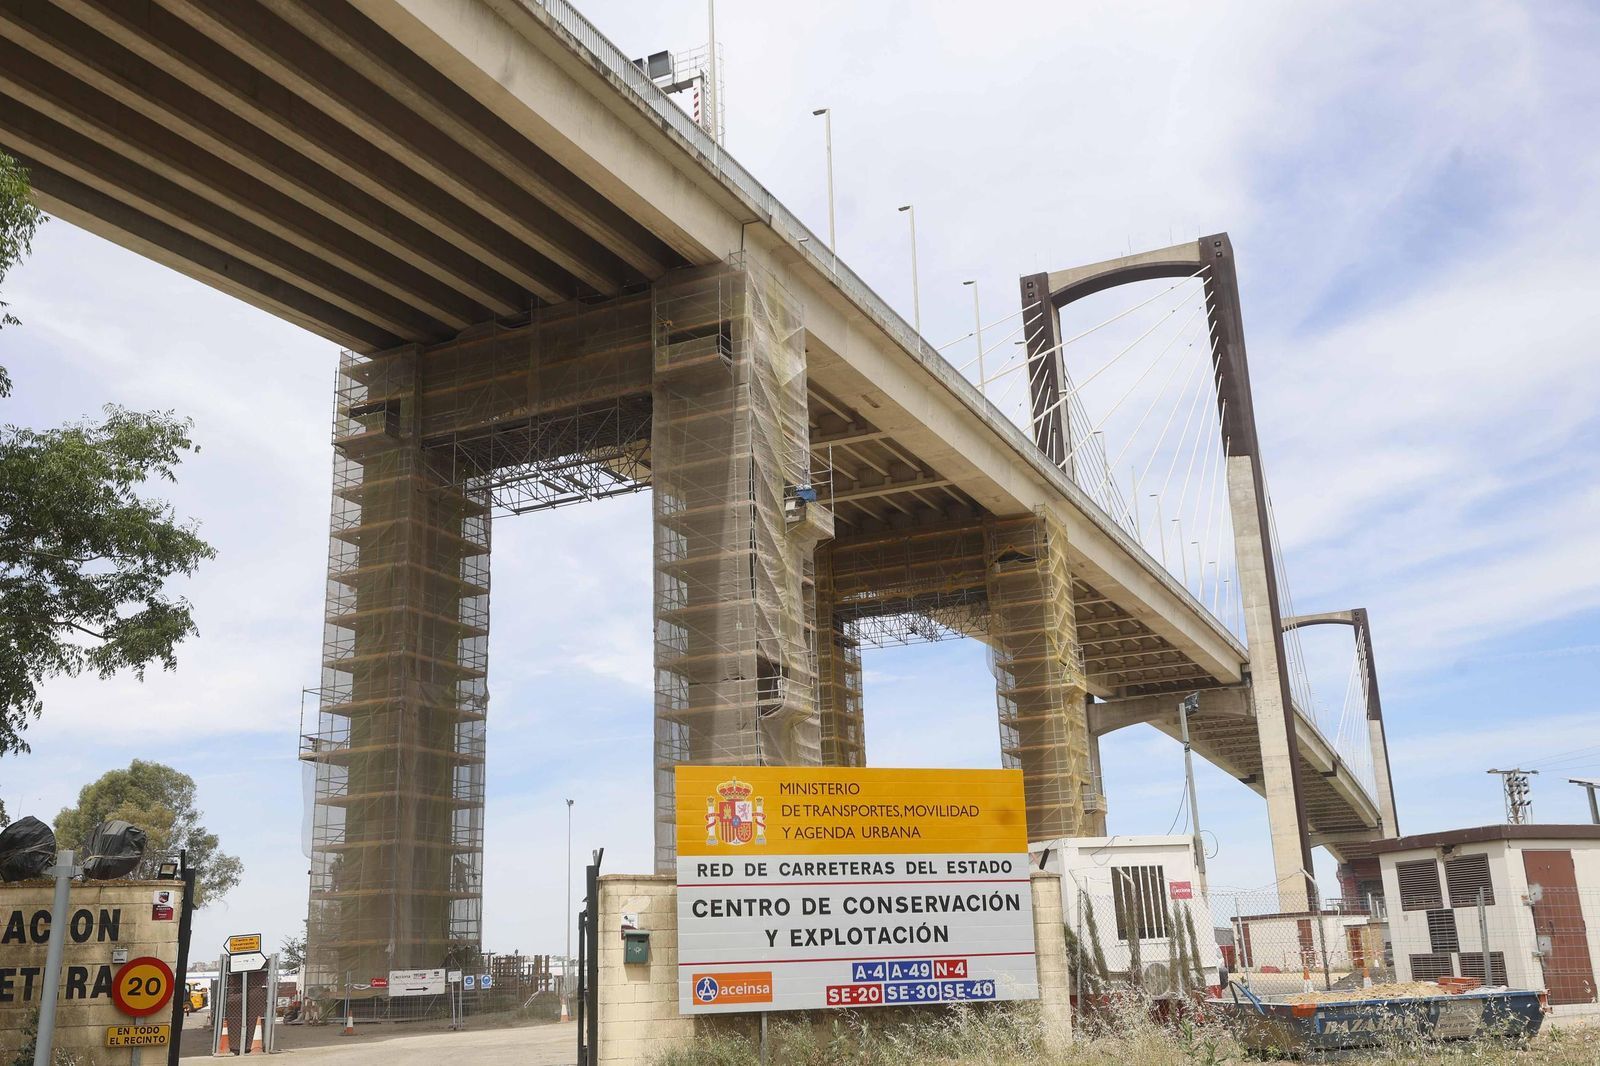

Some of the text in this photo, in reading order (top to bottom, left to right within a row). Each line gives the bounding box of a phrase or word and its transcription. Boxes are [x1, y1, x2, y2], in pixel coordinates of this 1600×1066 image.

[779, 782, 860, 795] MINISTERIO
[781, 805, 800, 817] DE
[782, 826, 921, 839] Y AGENDA URBANA
[697, 860, 1013, 878] RED DE CARRETERAS DEL ESTADO
[692, 891, 1020, 918] CENTRO DE CONSERVACIÓN
[1, 909, 121, 944] ACON
[765, 922, 949, 948] Y EXPLOTACIÓN
[856, 962, 965, 979] A-4 A-49 N-4
[127, 977, 161, 996] 20
[720, 983, 770, 996] aceinsa
[829, 982, 993, 1002] SE-20 SE-30 SE-40
[117, 1026, 160, 1035] EN TODO
[110, 1036, 166, 1045] EL RECINTO
